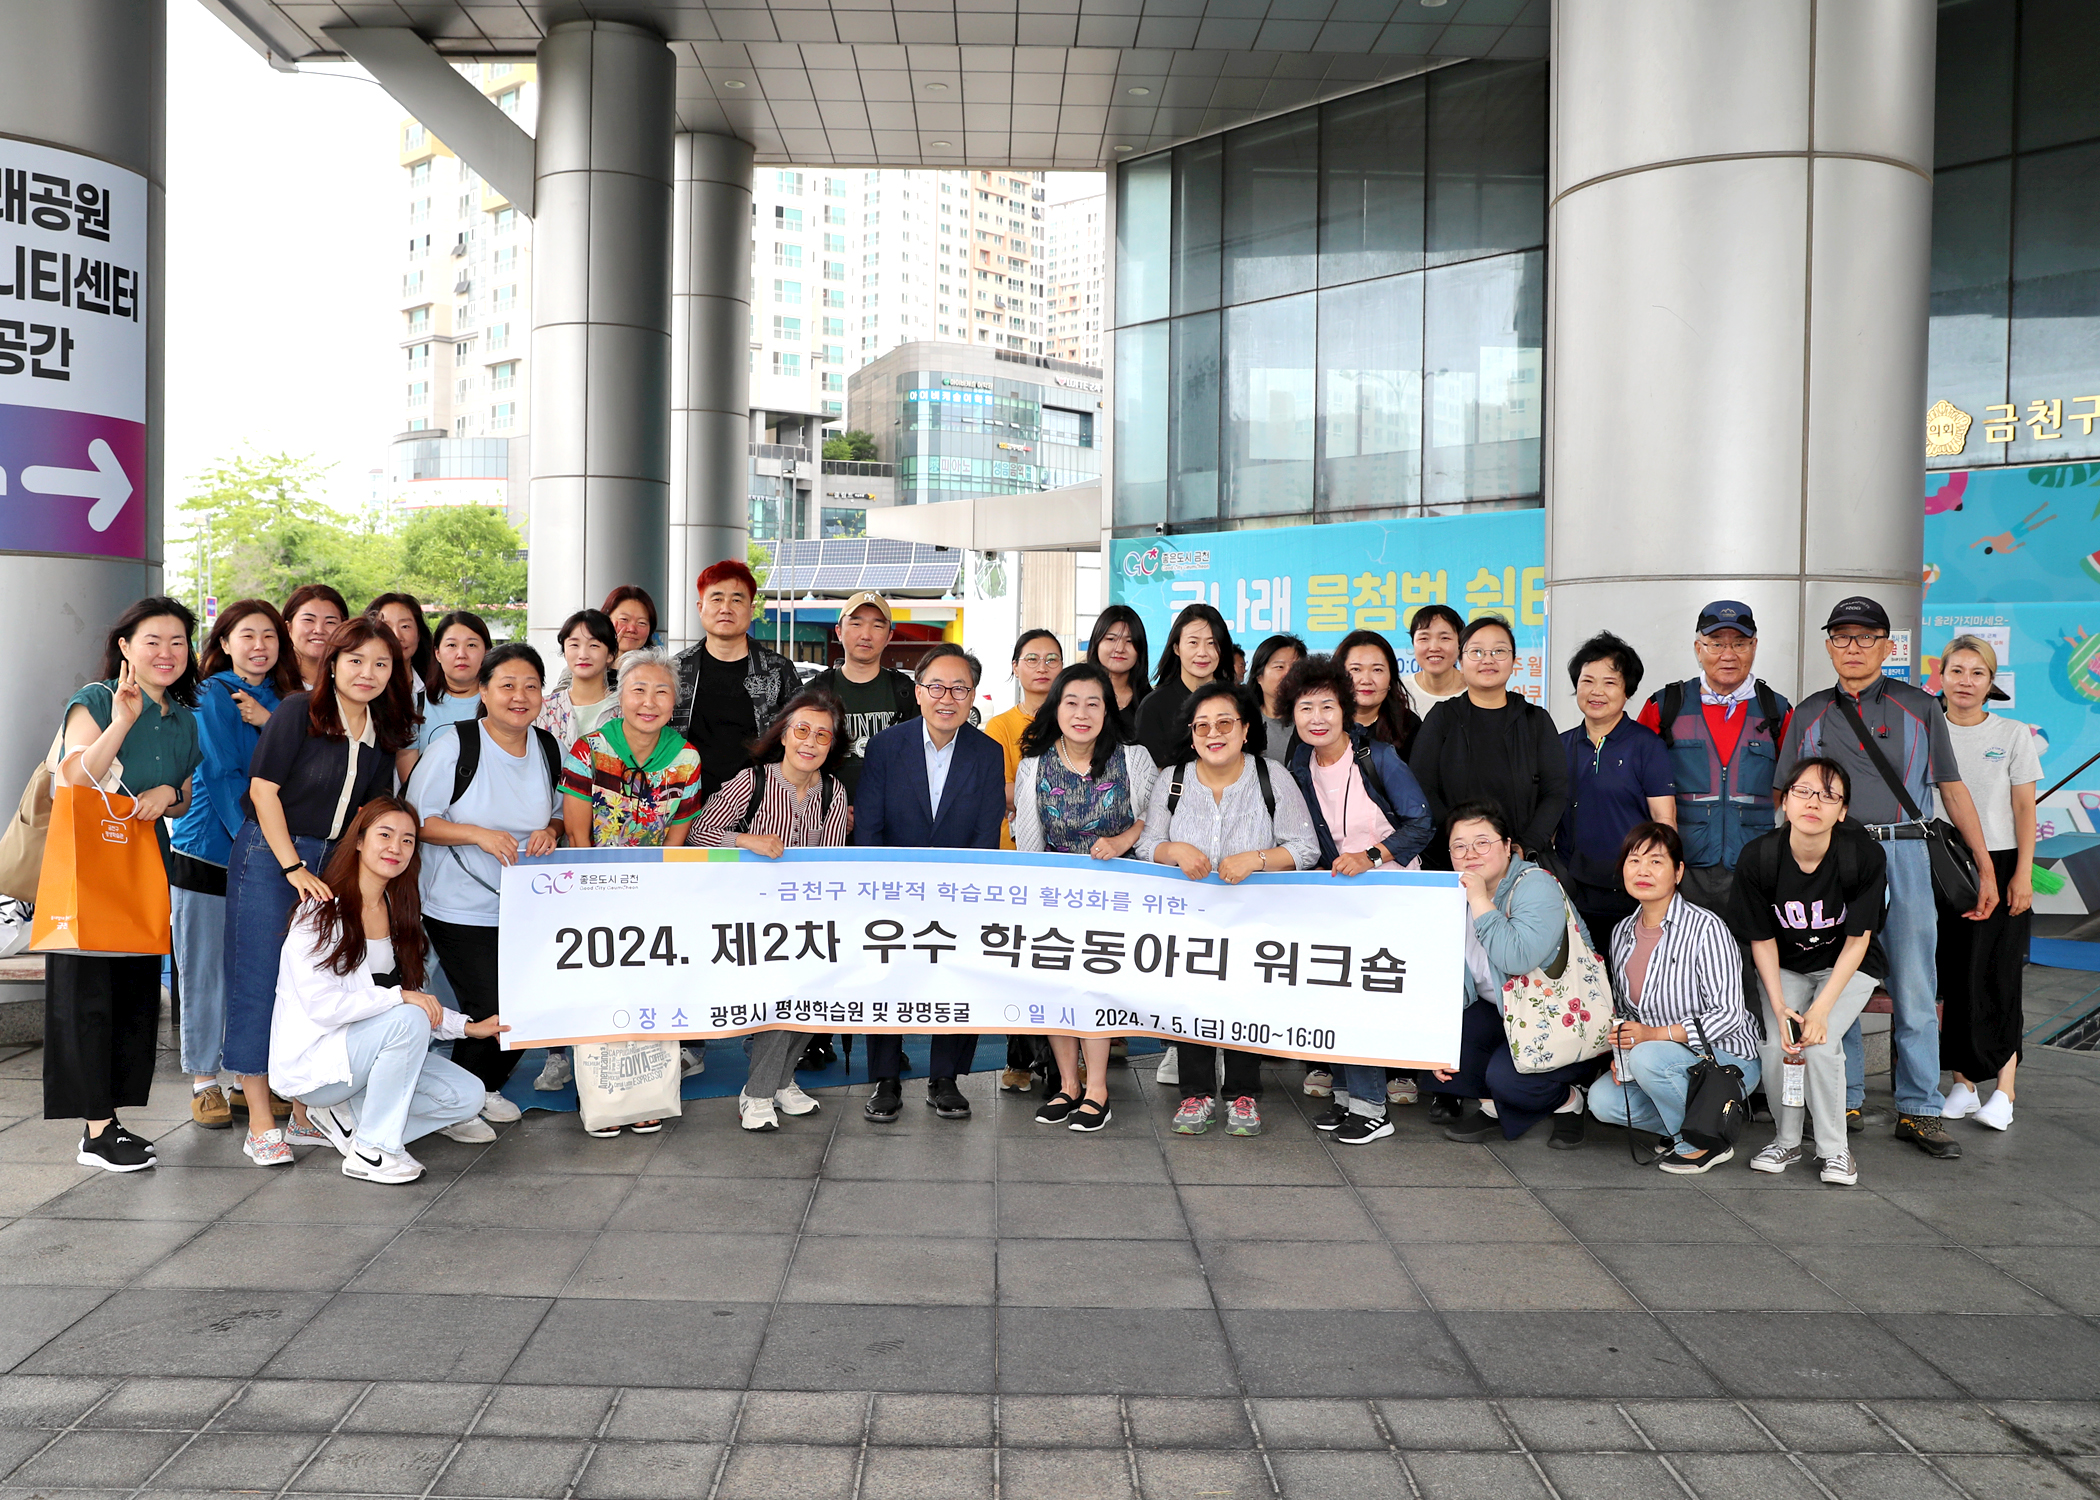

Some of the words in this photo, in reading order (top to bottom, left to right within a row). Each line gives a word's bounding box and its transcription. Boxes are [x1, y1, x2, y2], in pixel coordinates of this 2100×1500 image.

[1929, 423, 1954, 438] 의회
[1982, 395, 2100, 443] 금천구
[941, 458, 971, 473] 피아노
[1162, 552, 1192, 564] 좋은도시
[1194, 551, 1210, 562] 금천
[1306, 569, 1448, 631] 물첨벙
[579, 874, 617, 885] 좋은도시
[620, 874, 639, 884] 금천
[777, 880, 847, 901] 금천구
[857, 880, 926, 902] 자발적
[937, 881, 1028, 906] 학습모임
[1039, 886, 1132, 912] 활성화를
[1142, 894, 1188, 915] 위한
[556, 925, 690, 970] 2024.
[711, 920, 841, 966] 제2차
[862, 918, 957, 964] 우수
[980, 922, 1229, 981] 학습동아리
[1253, 940, 1407, 994] 워크숍
[710, 1001, 767, 1028] 광명시
[775, 999, 864, 1023] 평생학습원
[872, 1001, 888, 1023] 및
[896, 1002, 970, 1024] 광명동굴
[1095, 1008, 1144, 1028] 2024.
[1150, 1014, 1165, 1031] 7.
[1172, 1016, 1187, 1035] 5.
[1231, 1021, 1335, 1050] 9:00~16:00
[619, 1051, 651, 1078] EDIYA
[632, 1070, 663, 1086] ESPRESSO
[116, 1136, 132, 1144] FILA
